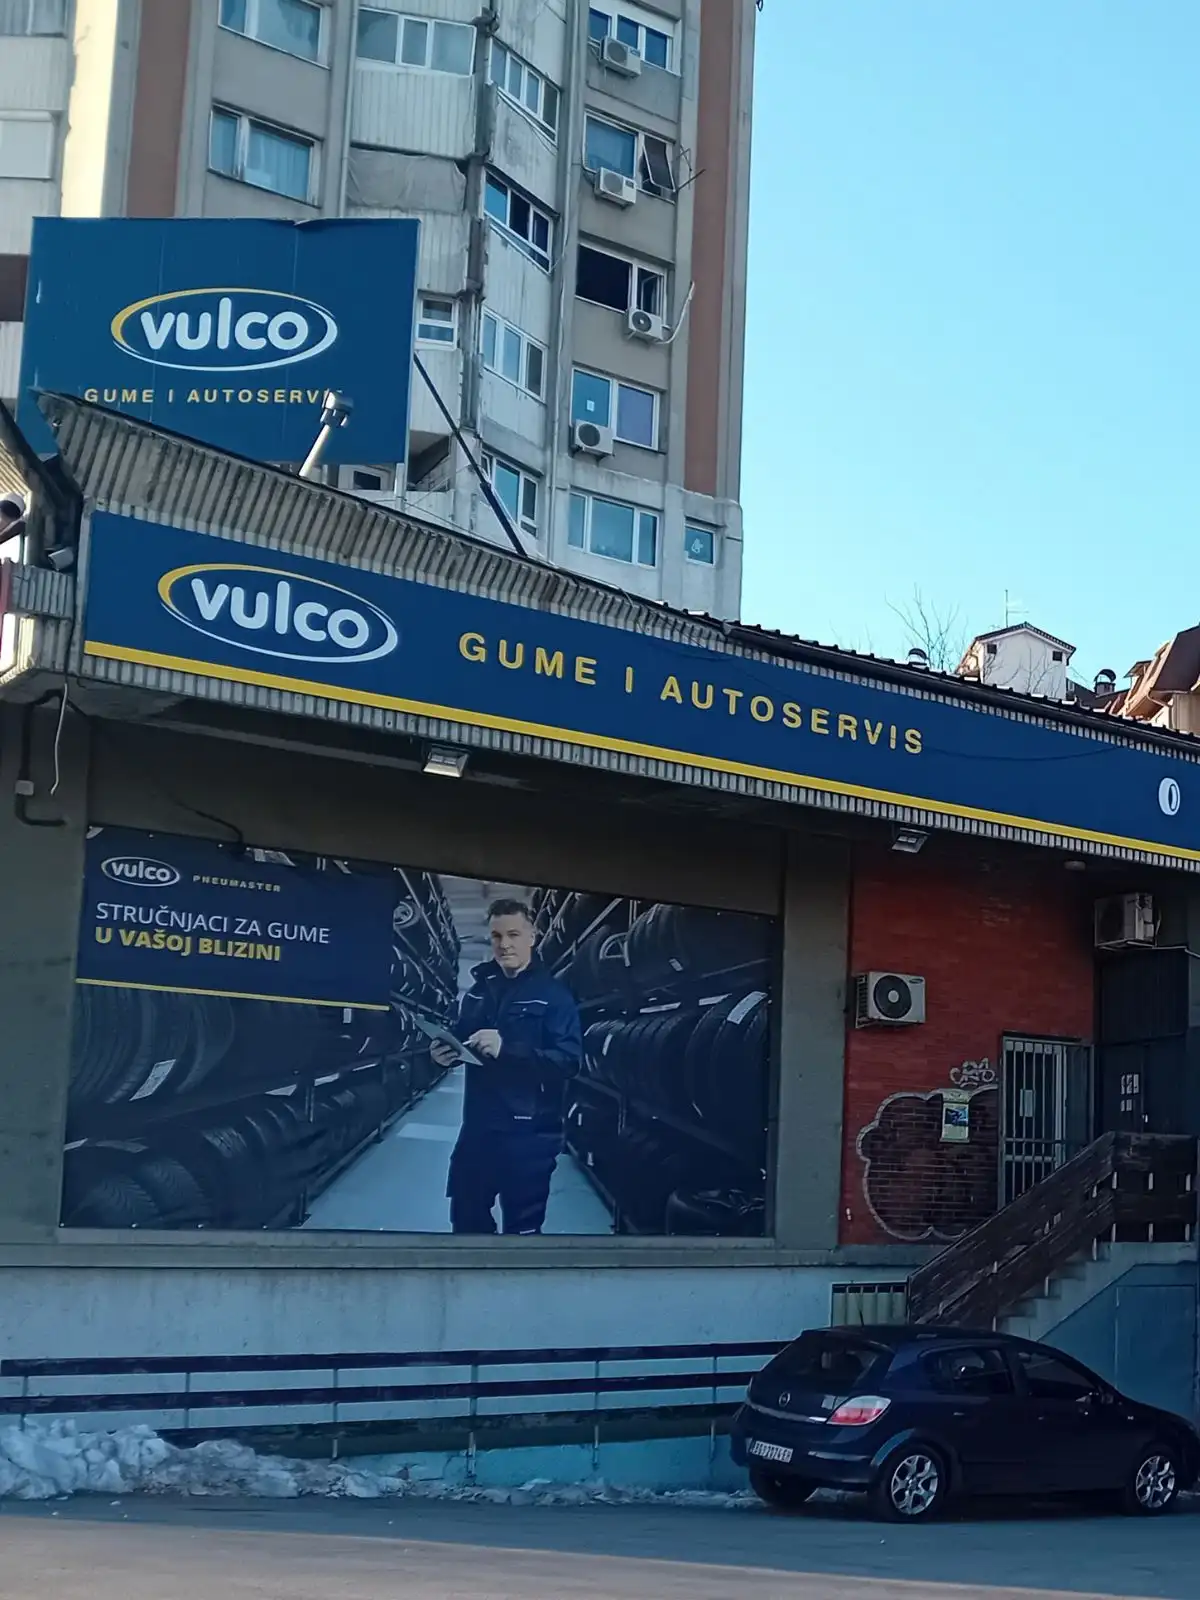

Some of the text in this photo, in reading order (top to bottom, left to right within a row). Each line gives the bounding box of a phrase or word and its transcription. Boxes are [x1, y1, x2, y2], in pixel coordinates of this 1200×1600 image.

[141, 297, 309, 350] vulco
[84, 388, 154, 404] GUME
[168, 389, 173, 403] I
[190, 577, 370, 649] vulco
[459, 632, 923, 754] GUME I AUTOSERVIS
[112, 860, 169, 881] vulco
[193, 875, 281, 893] PNEUMASTER
[96, 902, 330, 943] STRUČNJACI ZA GUME
[95, 927, 280, 961] U VAŠOJ BLIZINI
